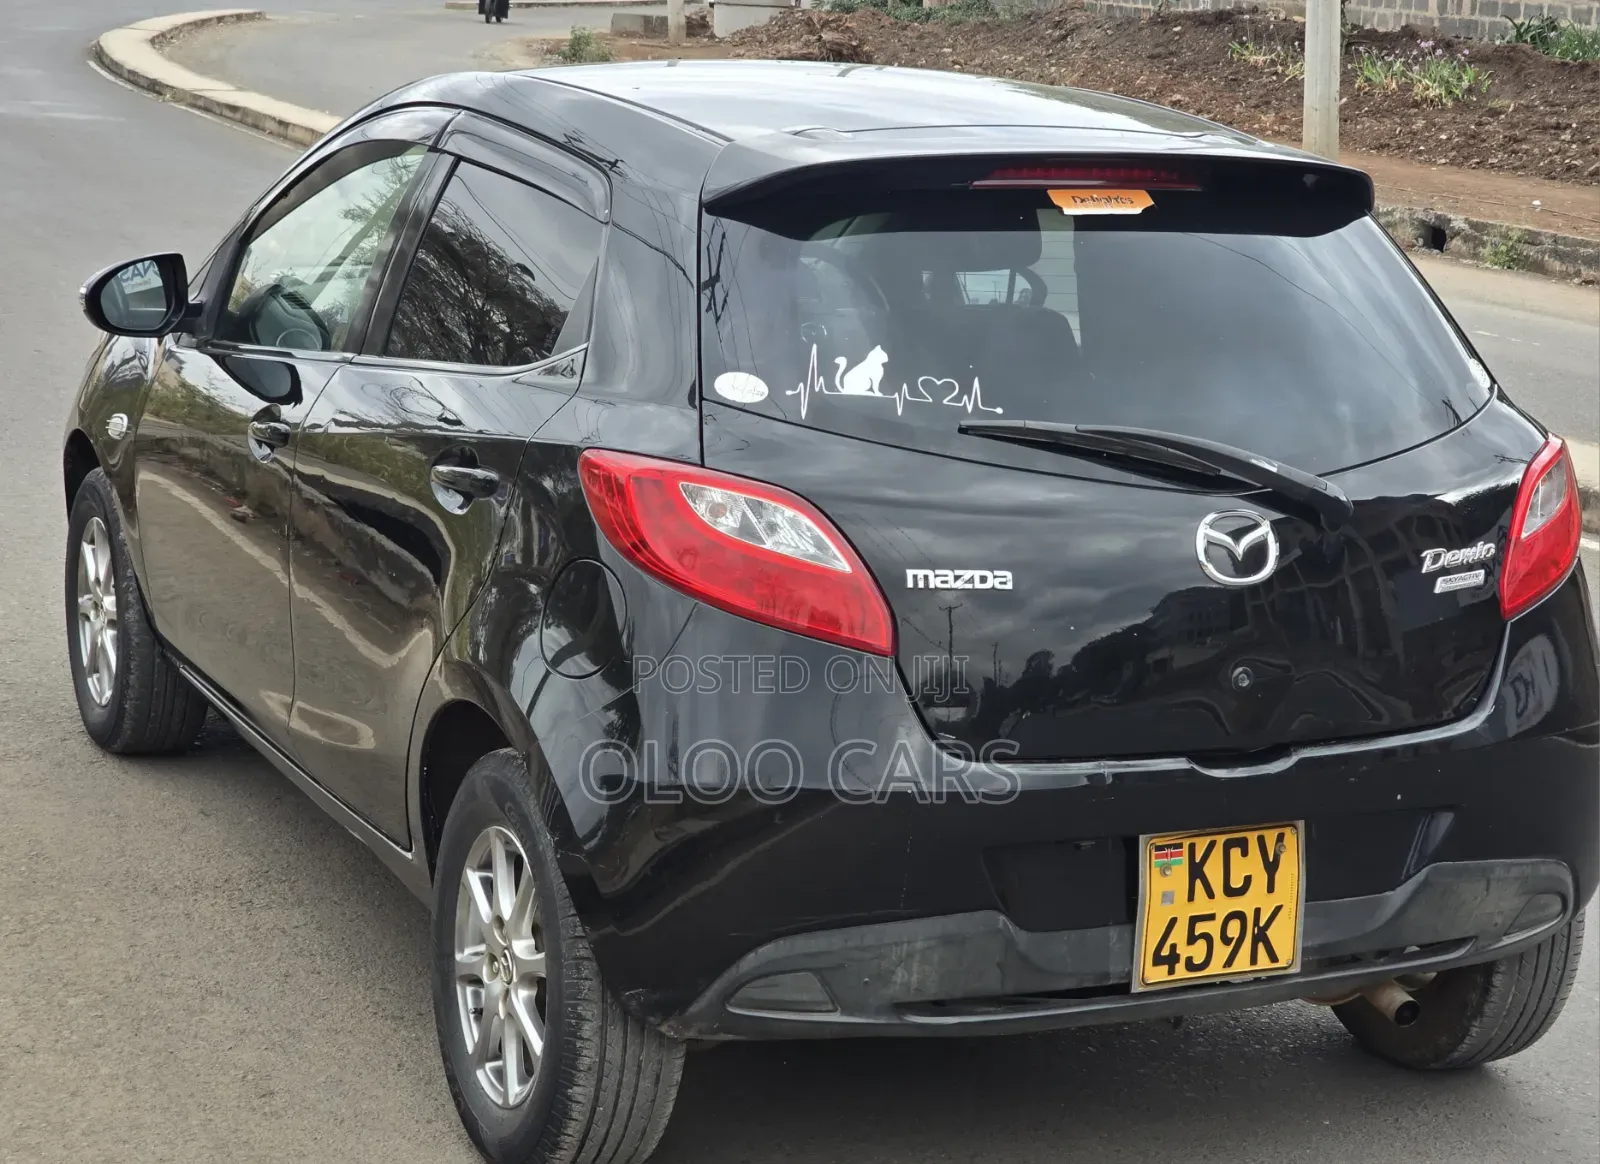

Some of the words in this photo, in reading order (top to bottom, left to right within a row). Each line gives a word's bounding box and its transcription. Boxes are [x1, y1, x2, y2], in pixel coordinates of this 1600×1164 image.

[1420, 541, 1495, 573] Demio
[1187, 832, 1285, 903] KCY
[1152, 904, 1284, 975] 459K
